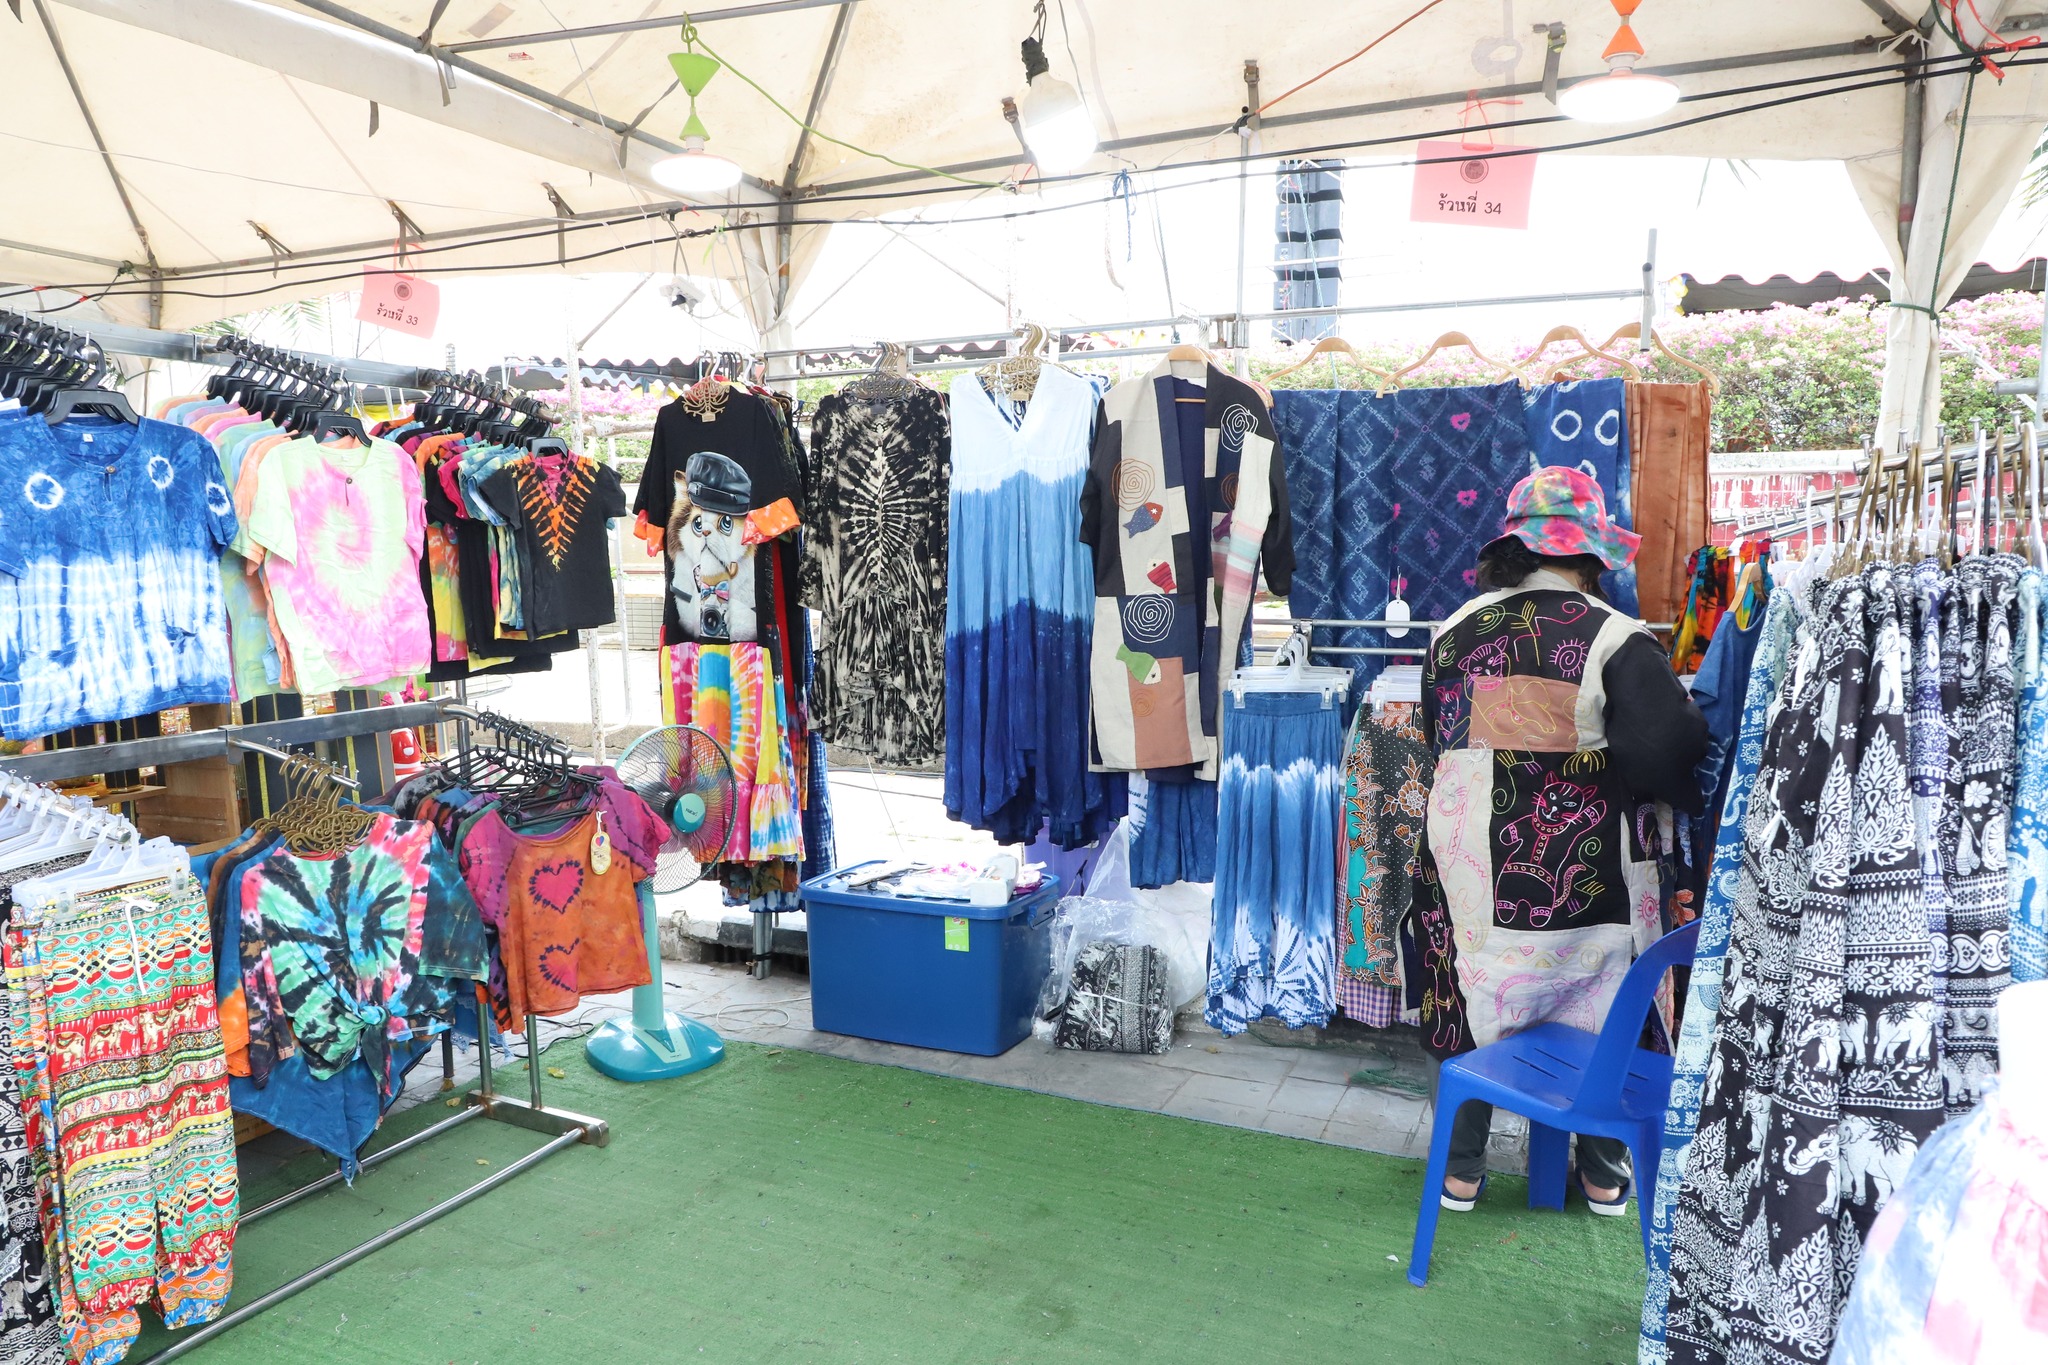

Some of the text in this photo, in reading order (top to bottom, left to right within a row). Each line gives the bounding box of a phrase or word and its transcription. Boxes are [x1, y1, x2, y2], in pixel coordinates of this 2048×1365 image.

[1438, 191, 1502, 215] ร้านที่ 34
[377, 302, 419, 326] ร้านที่ 33
